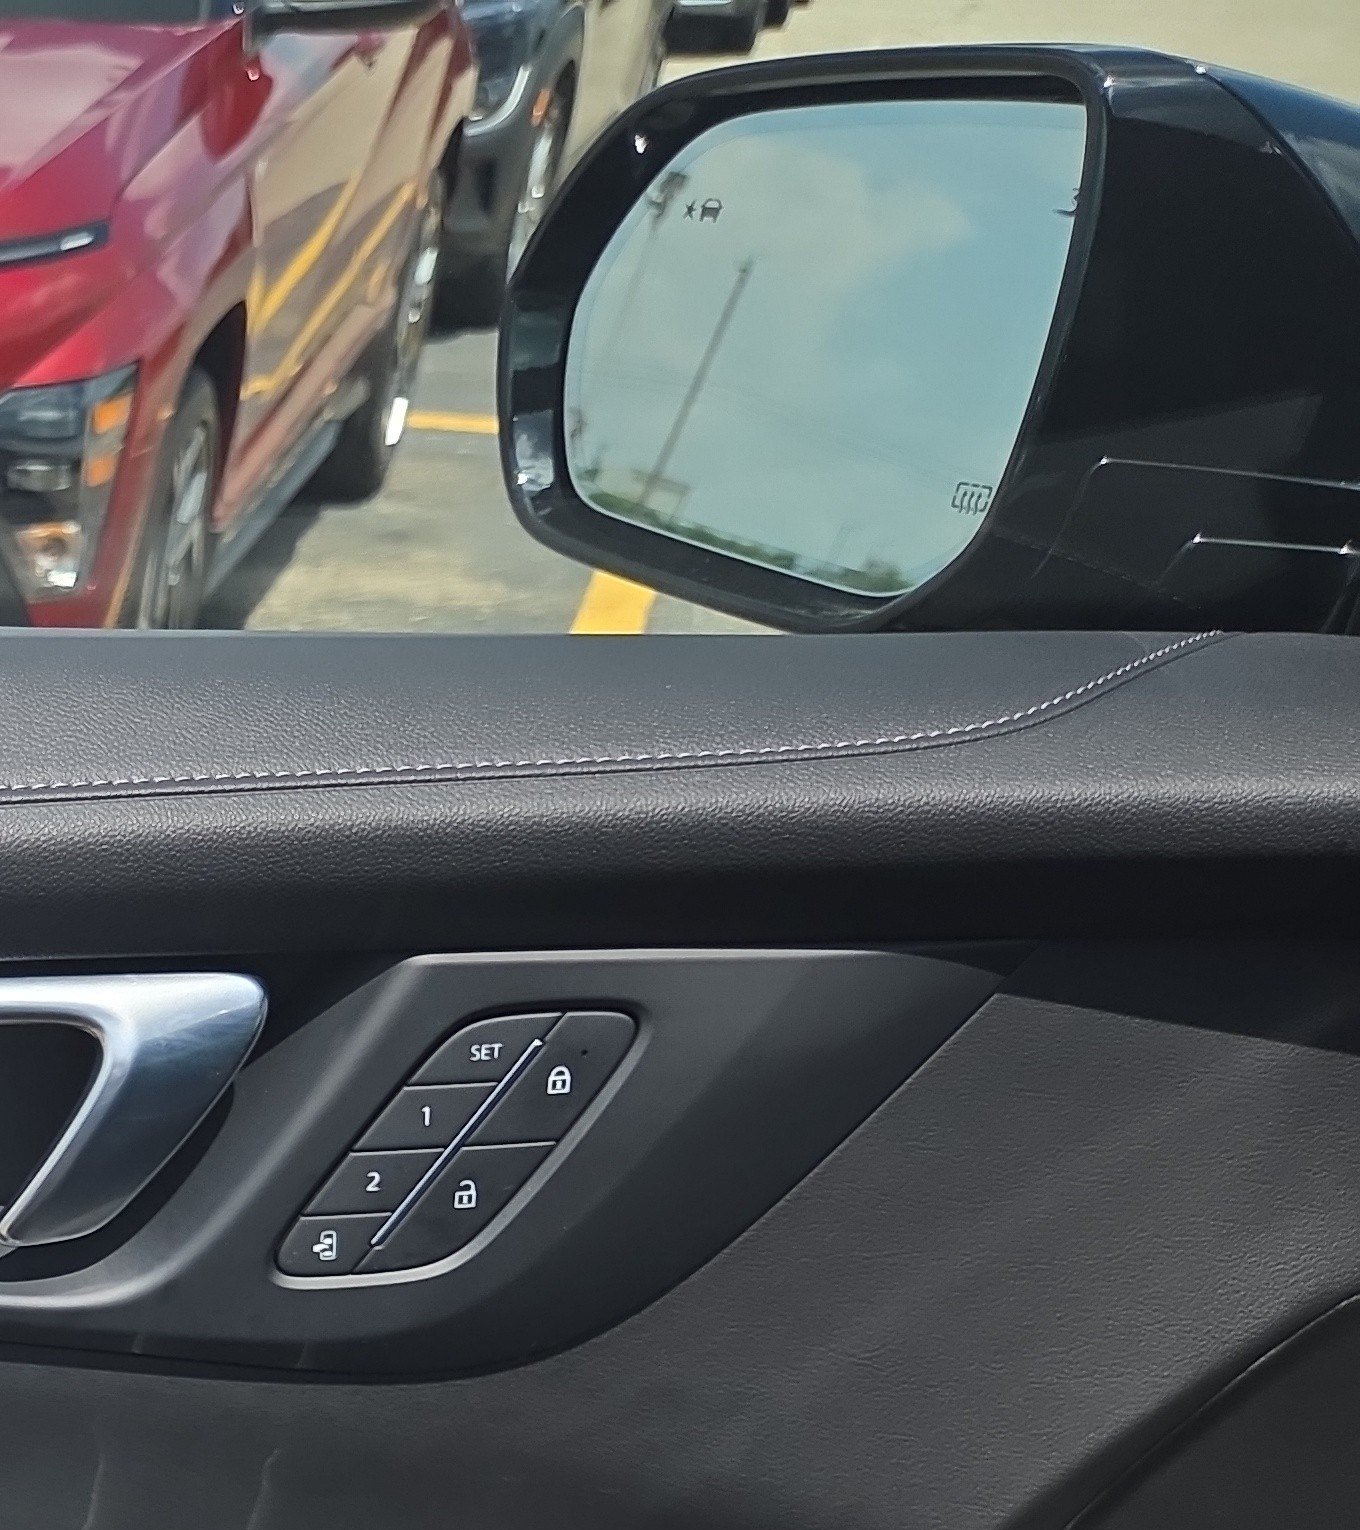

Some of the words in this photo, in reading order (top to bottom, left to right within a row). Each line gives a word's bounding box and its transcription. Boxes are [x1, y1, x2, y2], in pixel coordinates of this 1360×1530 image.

[469, 1043, 503, 1062] SET
[421, 1106, 431, 1127] 1
[365, 1172, 382, 1193] 2
